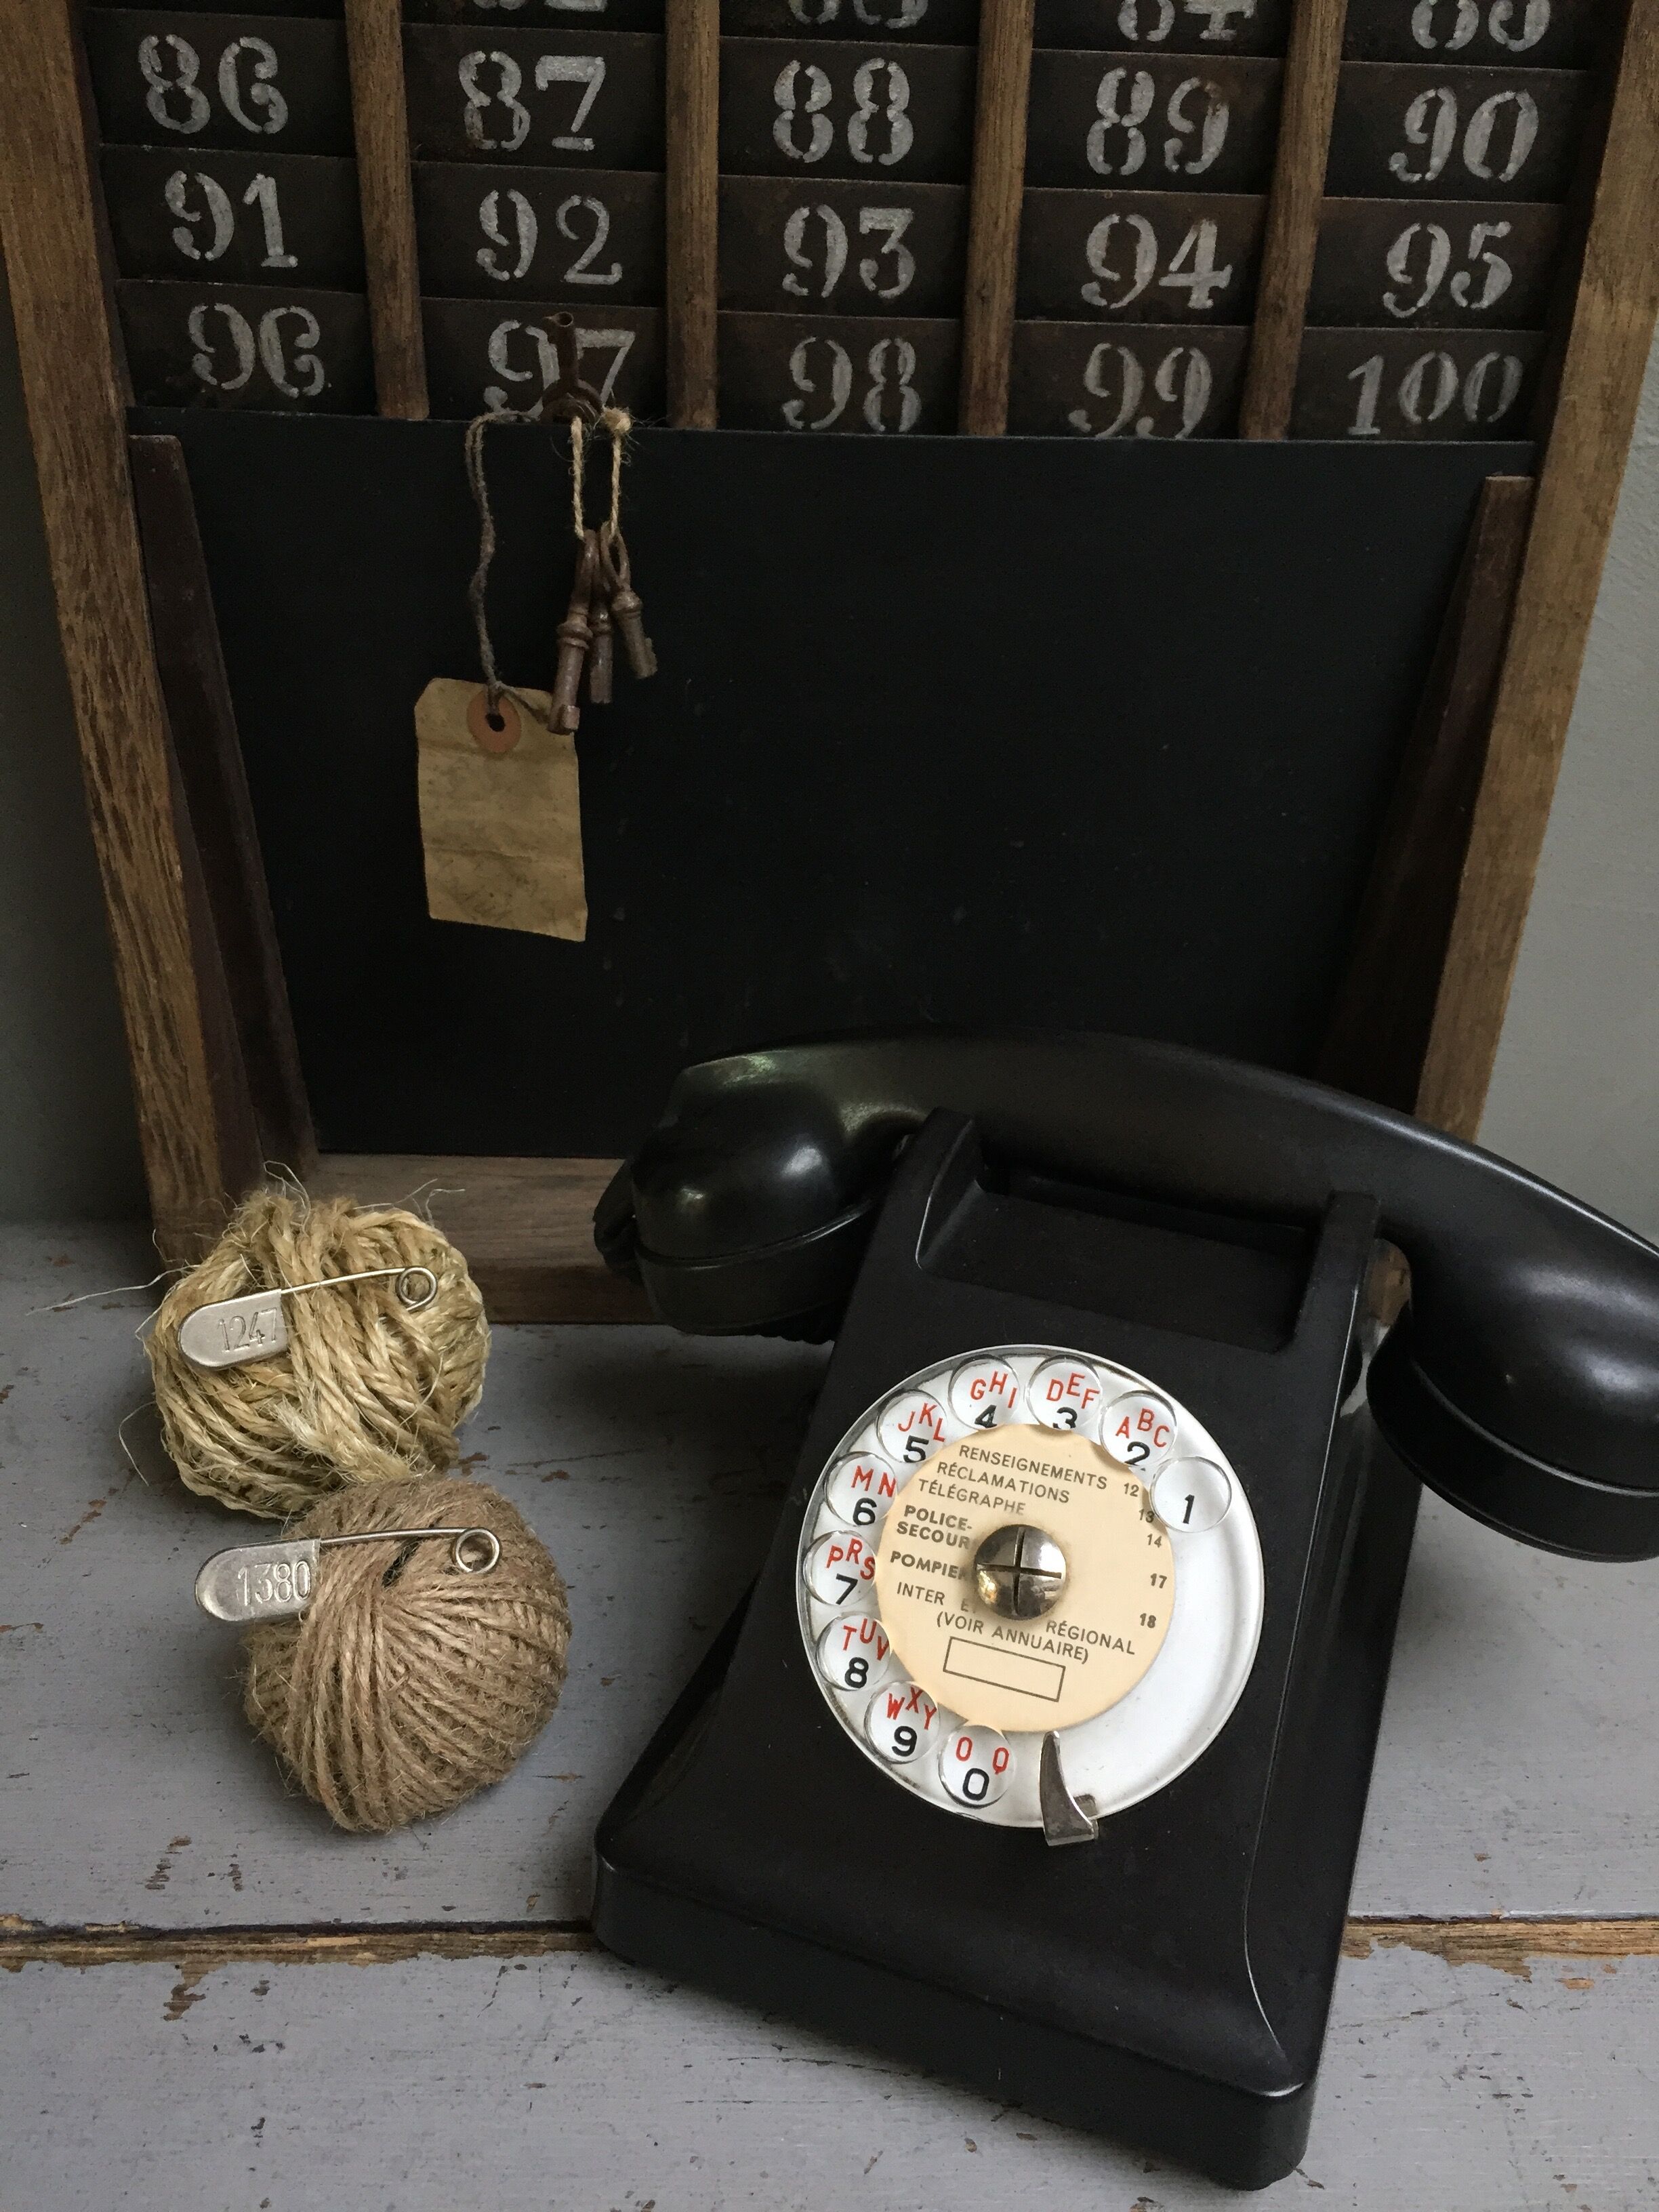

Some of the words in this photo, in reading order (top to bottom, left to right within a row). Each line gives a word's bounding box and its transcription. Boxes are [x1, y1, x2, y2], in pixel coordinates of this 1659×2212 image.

[138, 34, 289, 134] 86
[457, 51, 607, 151] 87
[773, 58, 914, 166] 88
[1086, 66, 1230, 176] 89
[1389, 85, 1540, 182] 90
[164, 169, 299, 268] 91
[476, 189, 623, 285] 92
[782, 204, 916, 299] 93
[1081, 213, 1233, 310] 94
[1382, 220, 1513, 319] 95
[188, 302, 325, 398] 96
[483, 319, 636, 422] 97
[782, 336, 922, 432] 98
[1068, 342, 1212, 439] 99
[1348, 350, 1523, 436] 100
[217, 1306, 278, 1353] 1247
[1046, 1372, 1101, 1410] DEF
[897, 1402, 946, 1443] JKL
[974, 1404, 998, 1429] 4
[1052, 1406, 1078, 1429] 3
[1115, 1408, 1170, 1448] ABC
[903, 1434, 930, 1464] 5
[959, 1444, 1108, 1490] RENSEIGNEMENTS
[1124, 1441, 1151, 1467] 2
[918, 1478, 1026, 1516] TÉLÉGRAPHE
[936, 1461, 1071, 1504] RÉCLAMATIONS
[1123, 1482, 1140, 1498] 12
[852, 1496, 878, 1526] 6
[903, 1504, 972, 1532] POLICE-
[1139, 1508, 1155, 1523] 13
[1182, 1494, 1195, 1525] 1
[825, 1538, 876, 1581] PRS
[1147, 1533, 1163, 1549] 14
[237, 1560, 311, 1607] 1380
[835, 1572, 859, 1605] 7
[1150, 1573, 1168, 1589] 17
[842, 1618, 890, 1661] TUV
[897, 1581, 945, 1606] INTER
[1046, 1620, 1136, 1656] RÉGIONAL
[937, 1611, 984, 1635] (VOIR
[991, 1625, 1090, 1664] ANNUAIRE)
[1140, 1612, 1157, 1629] 18
[844, 1656, 869, 1689] 8
[890, 1725, 918, 1757] 9
[962, 1767, 990, 1801] 0
